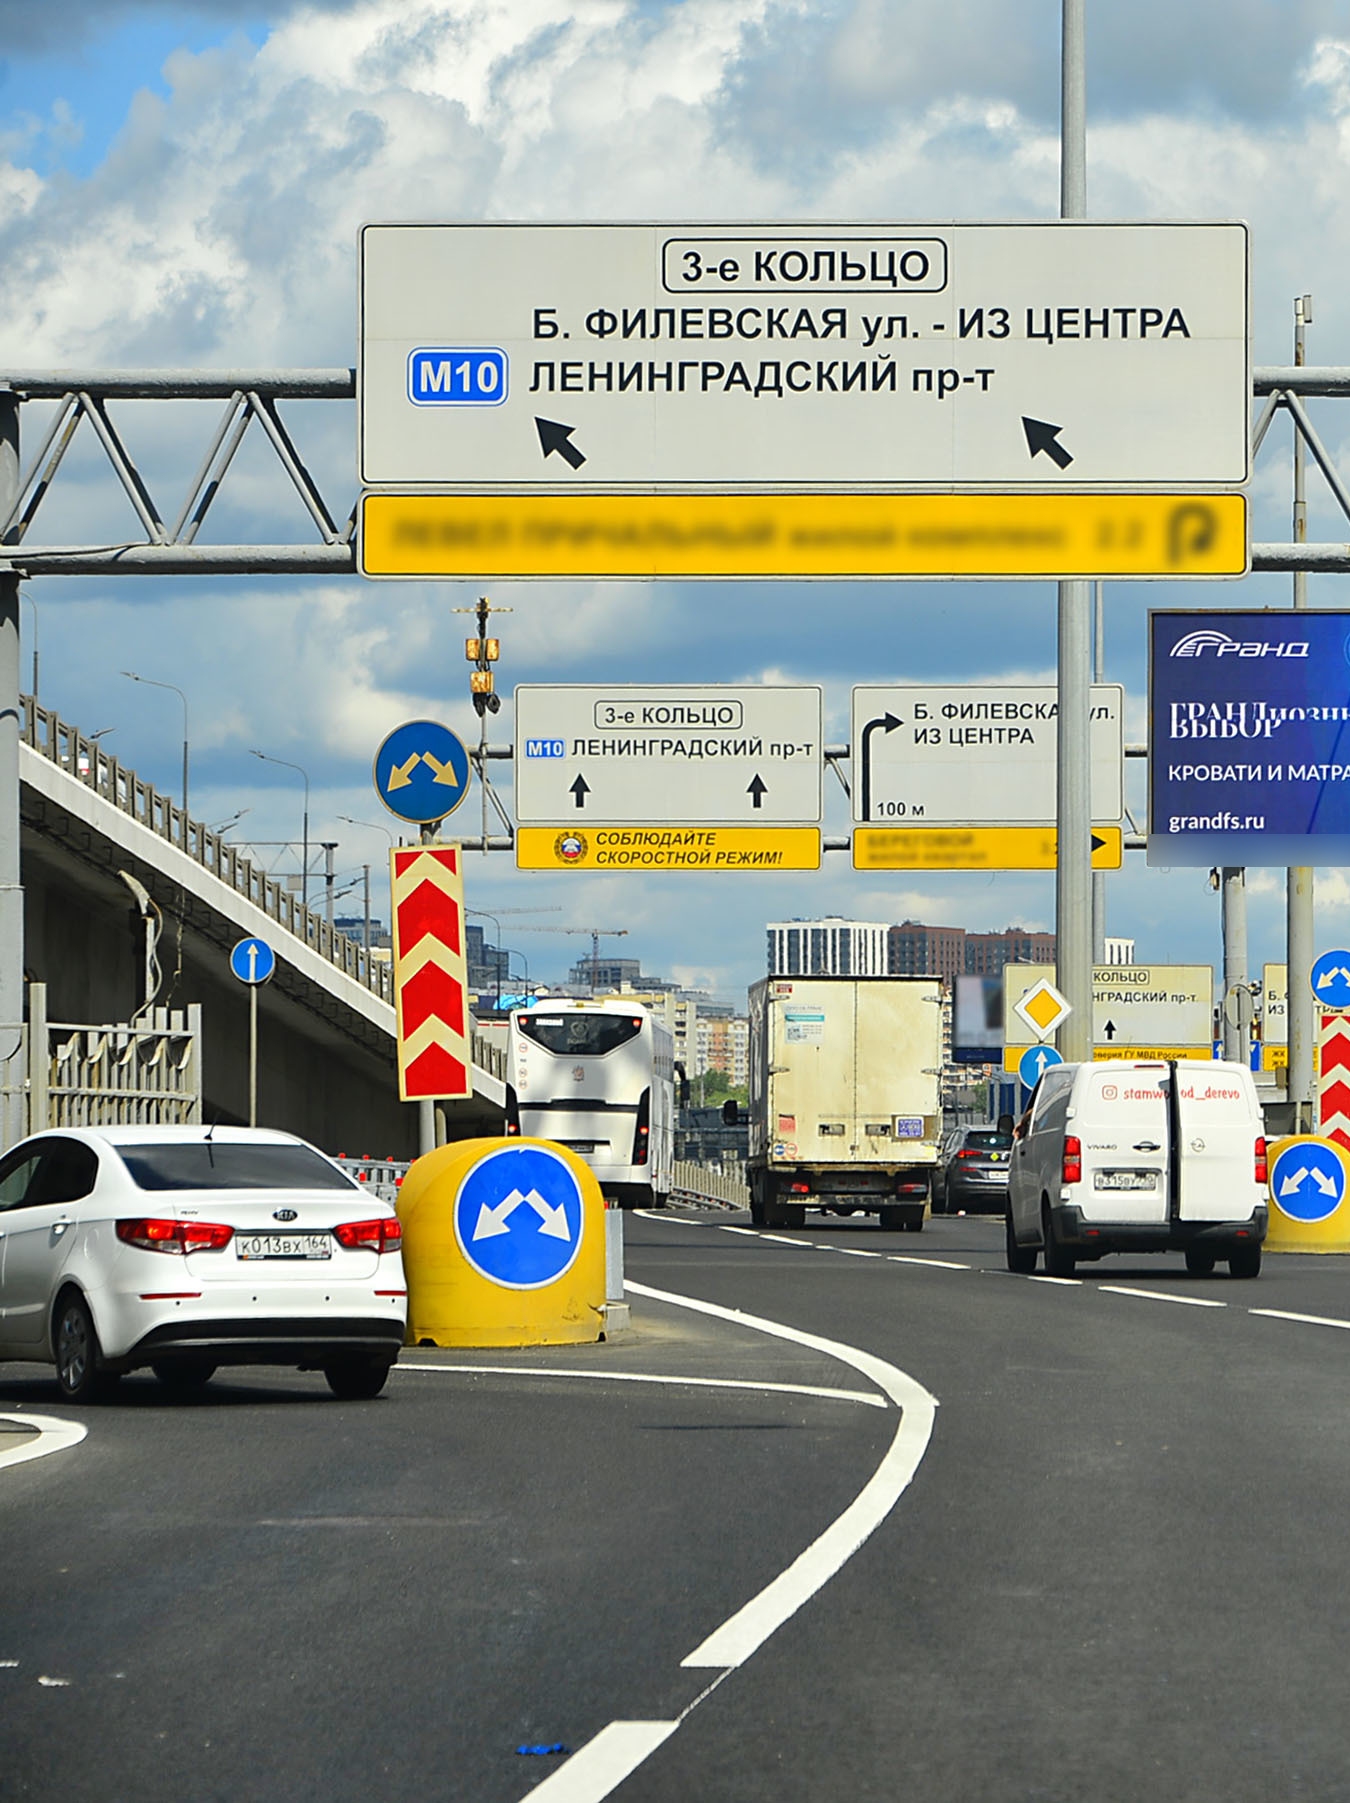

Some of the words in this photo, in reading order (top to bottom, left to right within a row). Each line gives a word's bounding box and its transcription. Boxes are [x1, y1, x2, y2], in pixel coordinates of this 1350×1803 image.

[682, 251, 740, 282] 3-е
[755, 250, 929, 288] КОЛЬЦО
[533, 308, 570, 339] Б.
[585, 307, 847, 340] ФИЛЕВСКАЯ
[861, 316, 919, 347] ул.
[959, 307, 1010, 339] ИЗ
[1026, 308, 1191, 345] ЦЕНТРА
[528, 354, 897, 397] ЛЕНИНГРАДСКИЙ
[912, 368, 995, 399] пр-т
[605, 707, 635, 724] 3-е
[642, 707, 734, 727] КОЛЬЦО
[914, 703, 934, 720] Б.
[941, 703, 1058, 720] ФИЛЕВСКА
[914, 727, 942, 745] ИЗ
[949, 727, 1035, 747] ЦЕНТРА
[571, 737, 763, 758] ЛЕНИНГРАДСКИЙ
[770, 743, 813, 761] пр-т
[1168, 764, 1262, 782] КРОВАТИ
[1267, 764, 1282, 781] И
[877, 801, 906, 816] 100
[1169, 811, 1265, 833] grandfs.ru
[596, 831, 717, 850] СОБЛЮДАЙТЕ
[596, 848, 712, 865] СКОРОСТНОЙ
[715, 851, 783, 865] РЕЖИМ!
[1093, 971, 1147, 984] КОЛЬЦО
[1093, 990, 1167, 1003] НГРАДСКИЙ
[1268, 1004, 1285, 1015] ИЗ
[305, 1234, 327, 1248] 164
